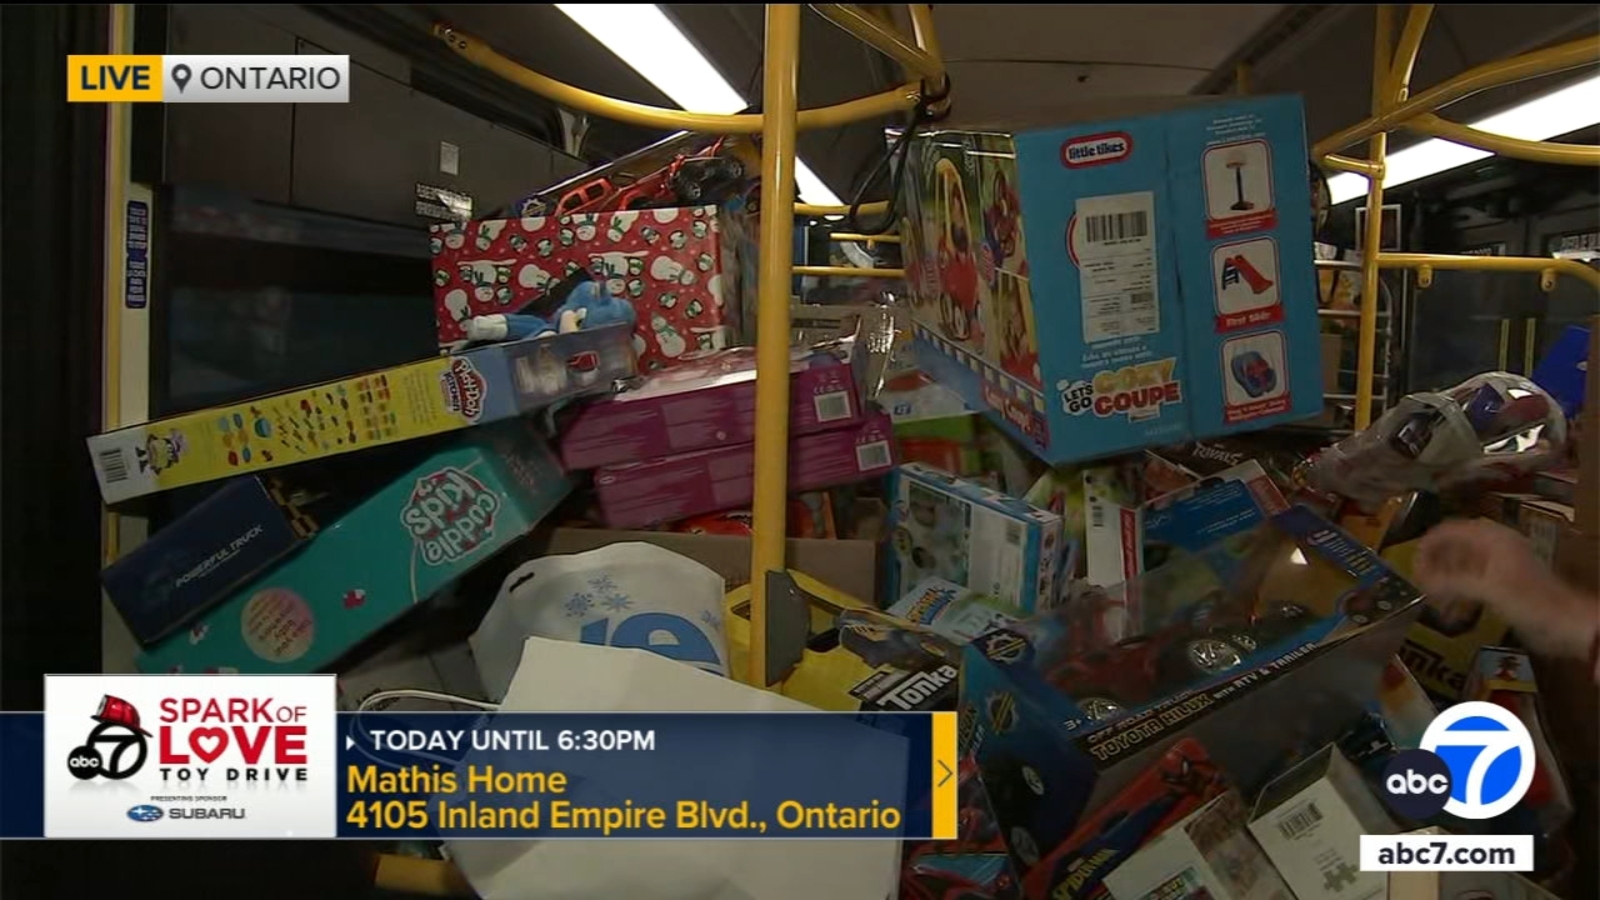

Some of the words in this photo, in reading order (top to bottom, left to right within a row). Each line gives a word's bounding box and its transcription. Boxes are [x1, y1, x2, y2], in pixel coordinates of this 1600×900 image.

[1069, 142, 1095, 161] little
[1096, 140, 1125, 158] tikes
[1063, 384, 1093, 403] LET'S
[1069, 396, 1092, 413] GO
[1094, 382, 1180, 414] COUPE
[405, 474, 475, 534] kids
[425, 496, 497, 560] cuddle
[175, 547, 229, 588] POWERFUL
[228, 524, 263, 551] TRUCK
[887, 664, 959, 710] Tonka
[1091, 717, 1164, 761] TOYOTA
[1160, 693, 1214, 725] HILUX
[1234, 672, 1258, 689] ATV
[1259, 666, 1270, 677] &
[1270, 641, 1317, 671] TRAILER
